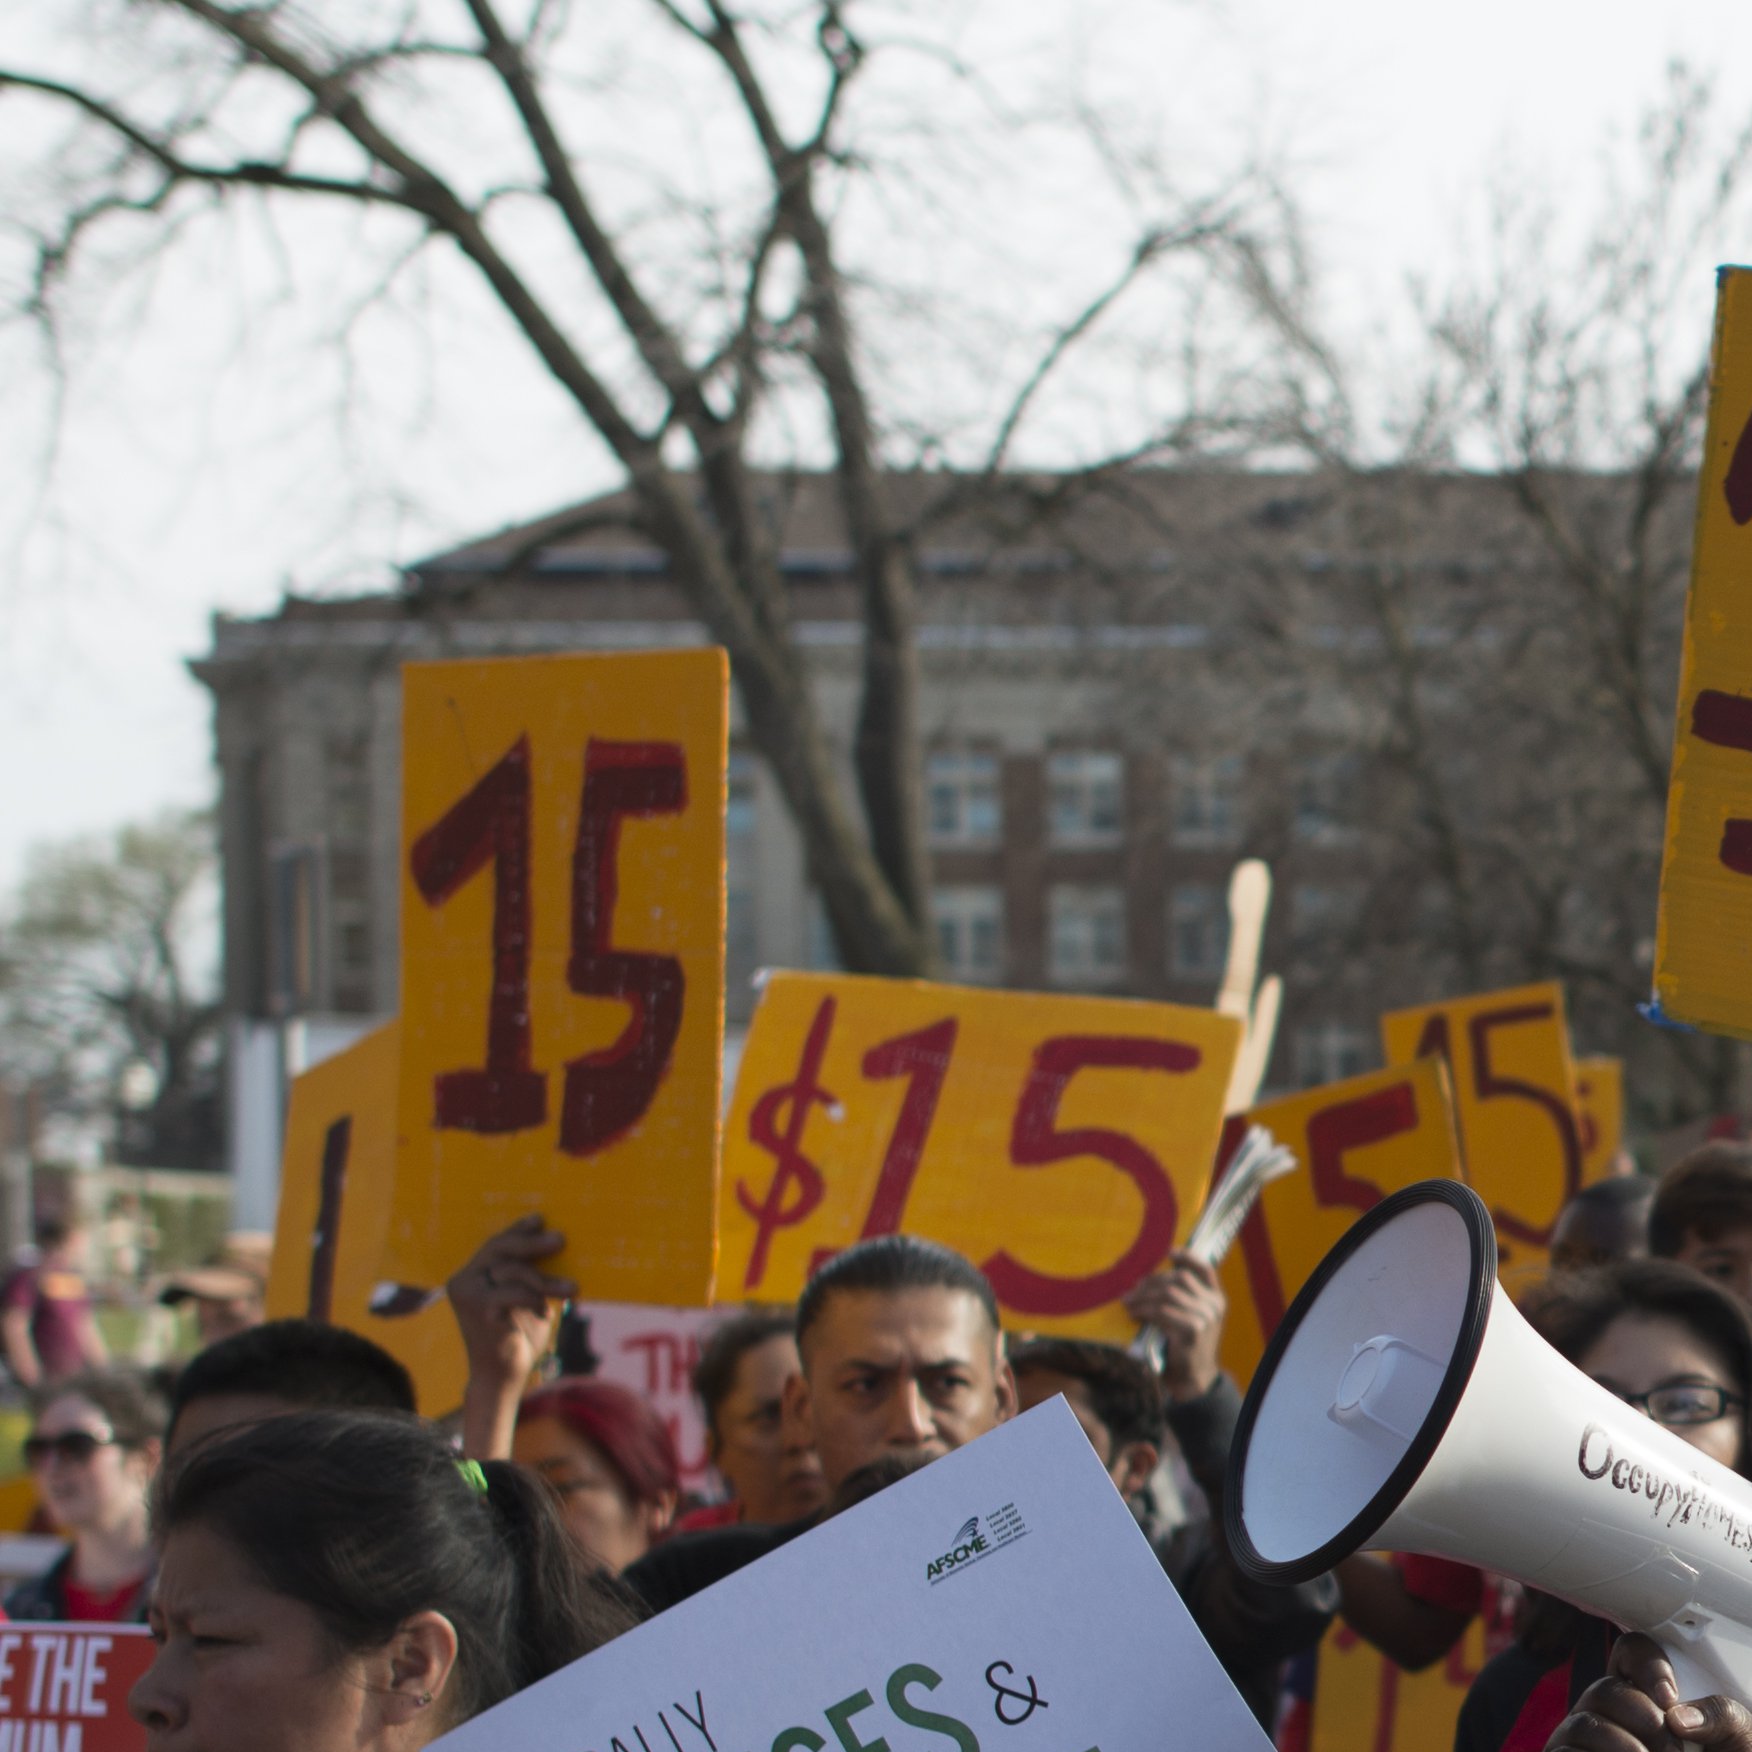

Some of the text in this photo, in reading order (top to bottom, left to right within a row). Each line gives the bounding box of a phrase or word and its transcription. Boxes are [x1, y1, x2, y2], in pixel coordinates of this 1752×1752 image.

[411, 730, 688, 1159] 15
[735, 994, 1201, 1317] $15
[927, 1534, 990, 1580] AFSCME
[29, 1636, 114, 1717] THE
[985, 1659, 1050, 1726] &
